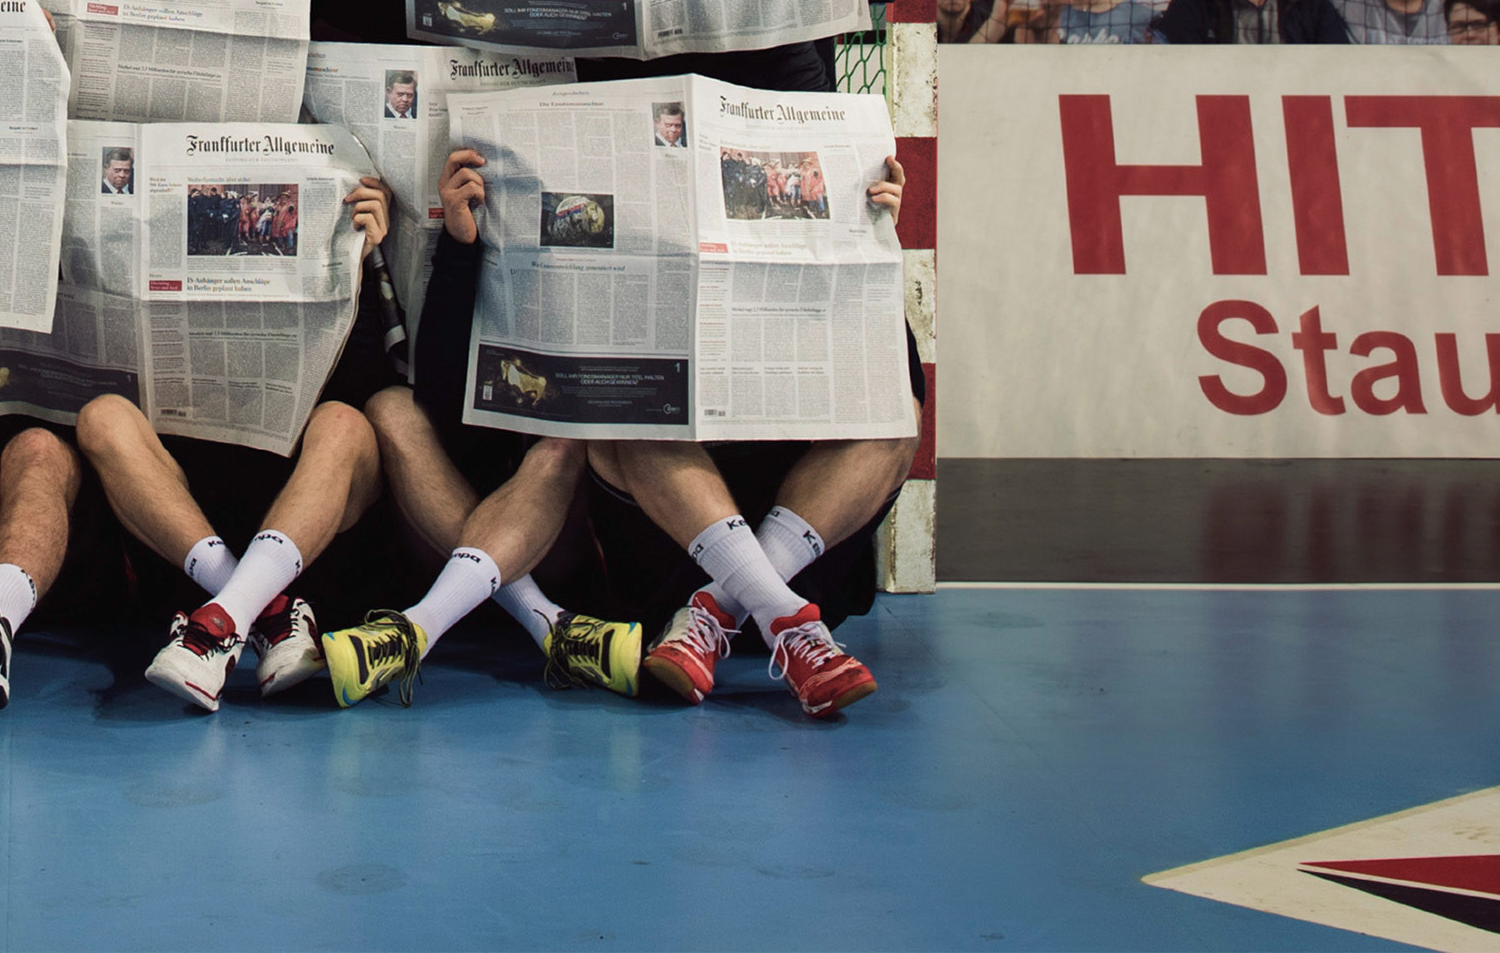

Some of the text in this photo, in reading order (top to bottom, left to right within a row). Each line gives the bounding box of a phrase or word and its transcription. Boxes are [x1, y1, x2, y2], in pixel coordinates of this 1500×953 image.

[450, 59, 510, 80] Frankfurter
[720, 95, 846, 124] Frankfurter Allgemeine
[186, 135, 335, 156] Frankfurter Allgemeine
[1058, 93, 1500, 277] HIT
[1196, 299, 1500, 417] Stau
